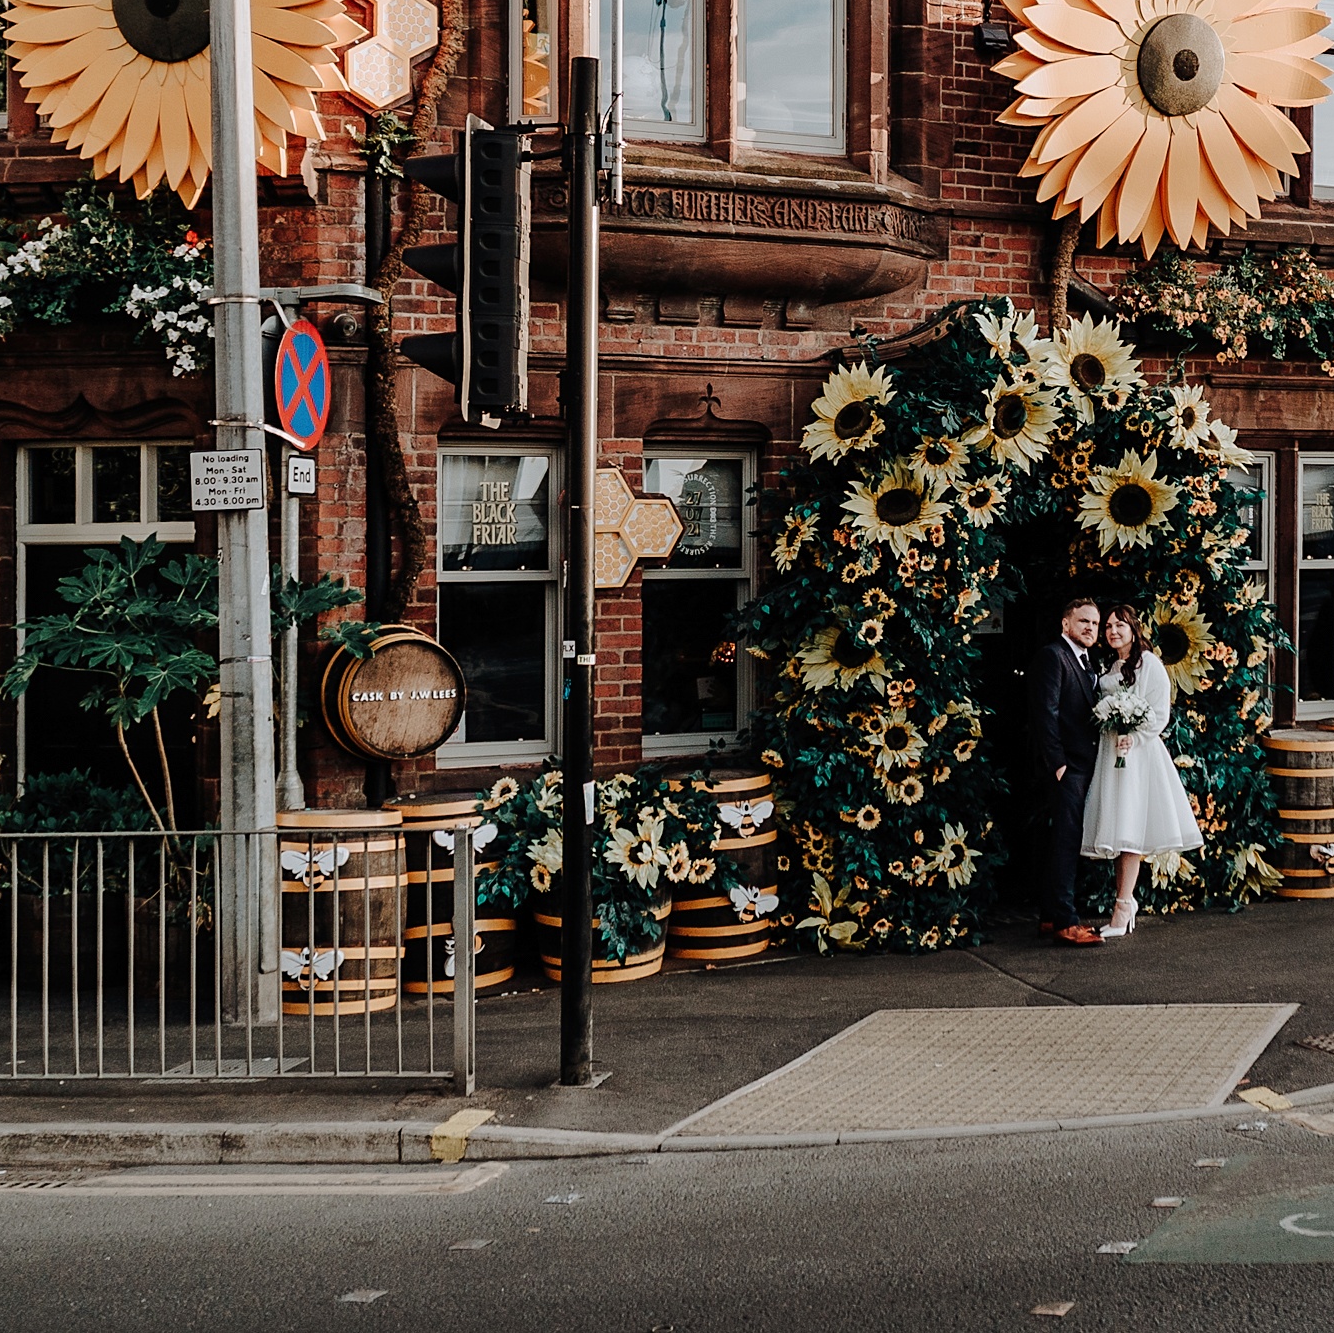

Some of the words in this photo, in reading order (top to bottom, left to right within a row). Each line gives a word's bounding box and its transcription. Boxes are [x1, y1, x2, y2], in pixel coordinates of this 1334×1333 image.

[202, 455, 215, 463] No
[217, 454, 249, 463] loading
[206, 467, 225, 475] Mon
[231, 465, 247, 474] Sat
[293, 466, 311, 484] End
[195, 477, 216, 485] 8.00
[223, 476, 244, 484] 9.30
[208, 488, 227, 496] Mon
[234, 487, 246, 495] Fri
[480, 482, 510, 502] THE
[683, 473, 717, 505] SURRECTION
[195, 498, 216, 507] 4.30
[223, 496, 244, 505] 6.00
[246, 497, 259, 506] pm
[686, 491, 702, 505] 27
[1315, 493, 1330, 505] THE
[472, 503, 518, 523] BLACK
[685, 507, 703, 521] 07
[1311, 505, 1334, 518] BLACK
[687, 523, 701, 537] 21
[1311, 518, 1334, 531] FRIAR
[473, 524, 517, 544] FRIAR
[709, 524, 717, 540] THE
[676, 540, 713, 556] RESURREC
[351, 691, 384, 702] CASK
[389, 691, 404, 701] BY
